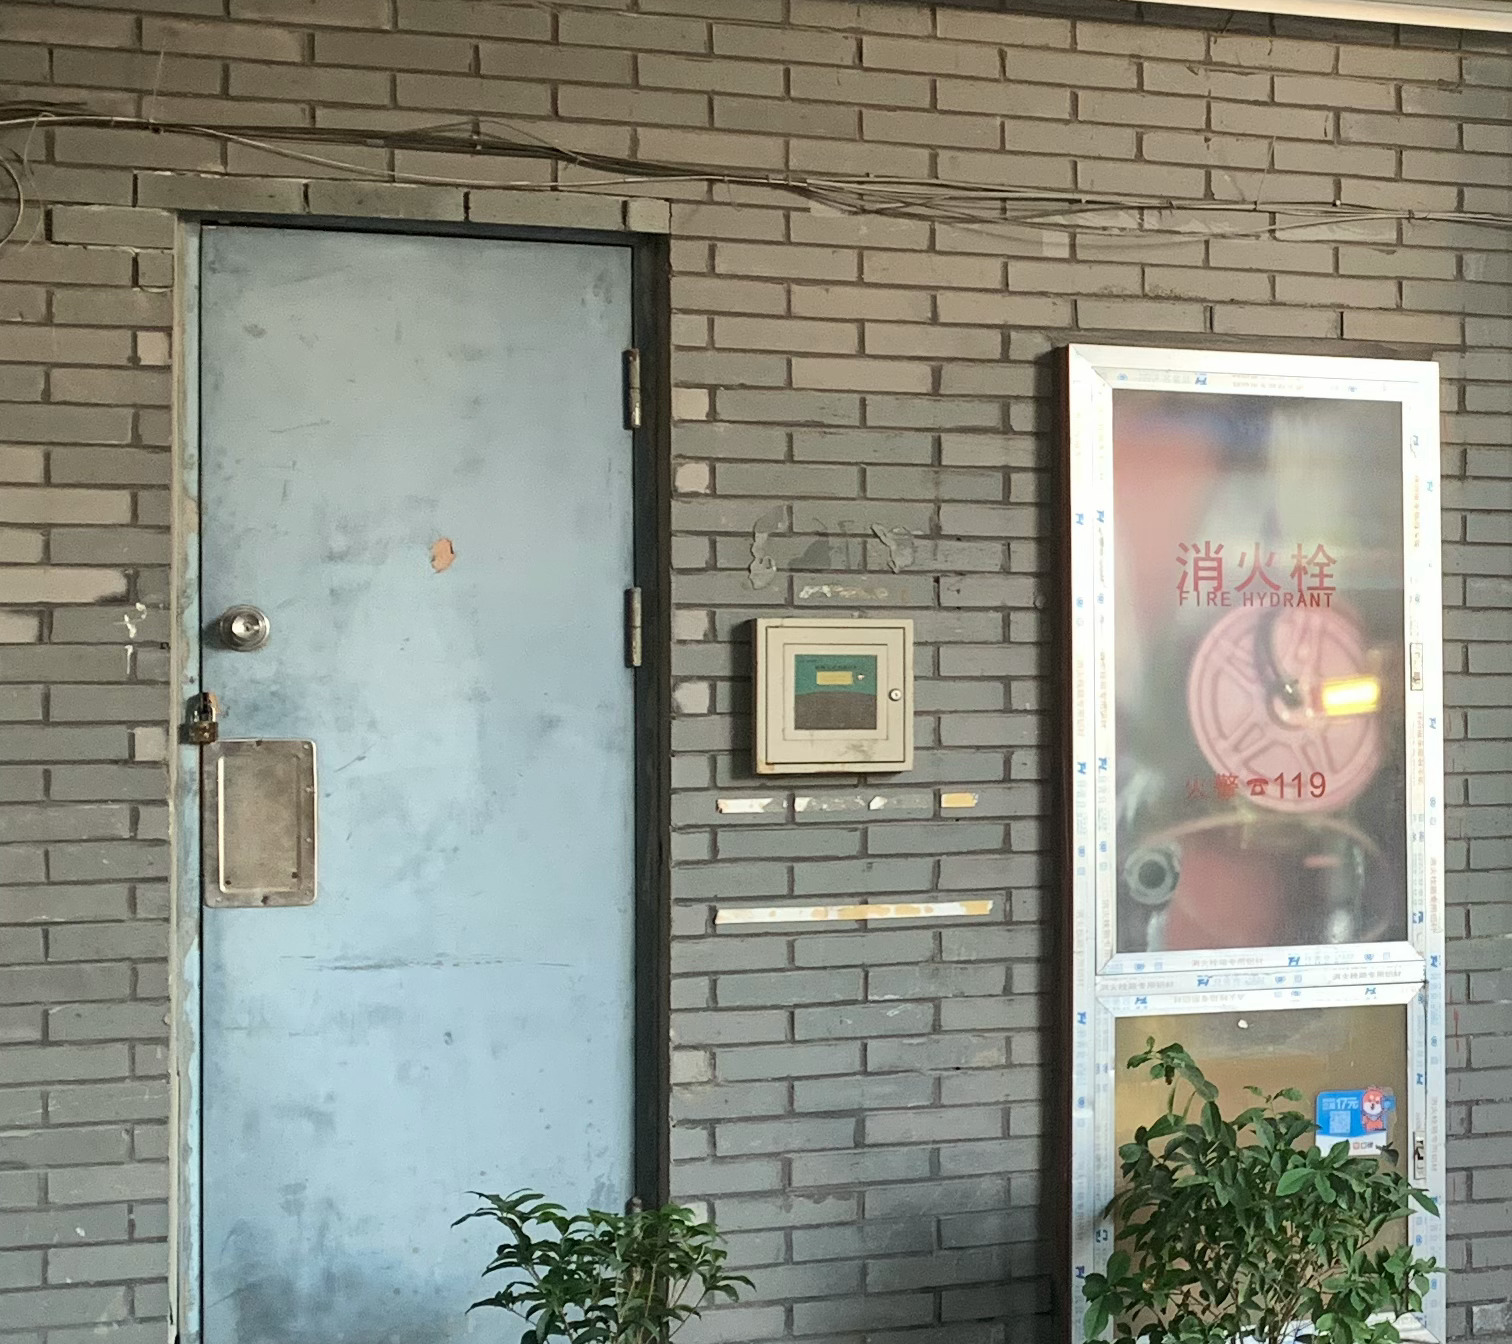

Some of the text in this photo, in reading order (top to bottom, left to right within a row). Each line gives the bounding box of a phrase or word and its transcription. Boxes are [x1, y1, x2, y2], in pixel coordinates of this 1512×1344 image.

[1175, 540, 1337, 593] 消火栓
[1179, 590, 1333, 608] FIRE HYDRANT
[1273, 771, 1327, 799] 119
